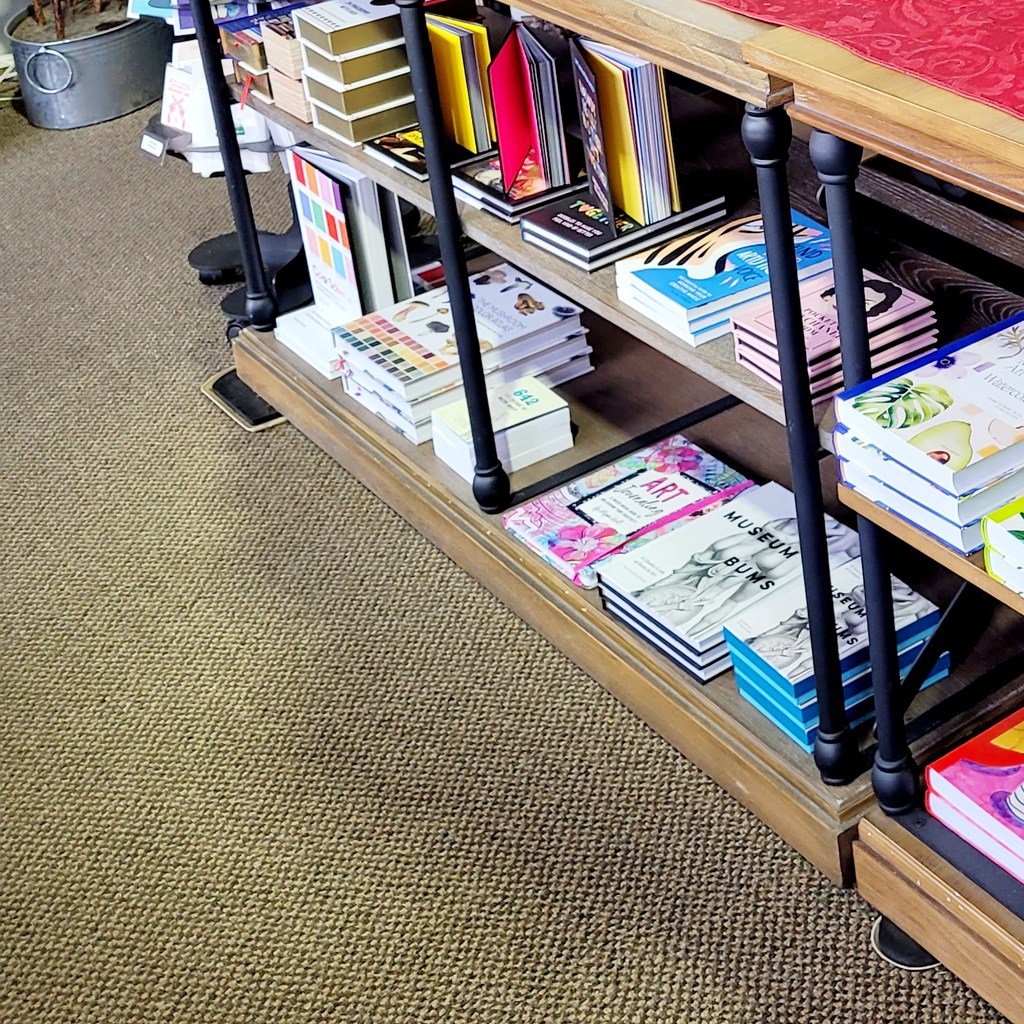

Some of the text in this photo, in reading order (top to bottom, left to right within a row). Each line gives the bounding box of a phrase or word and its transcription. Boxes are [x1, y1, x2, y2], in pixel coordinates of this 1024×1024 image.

[513, 388, 539, 407] 642
[640, 477, 689, 503] ART
[723, 510, 800, 560] MUSEUM
[723, 556, 777, 592] BUMS
